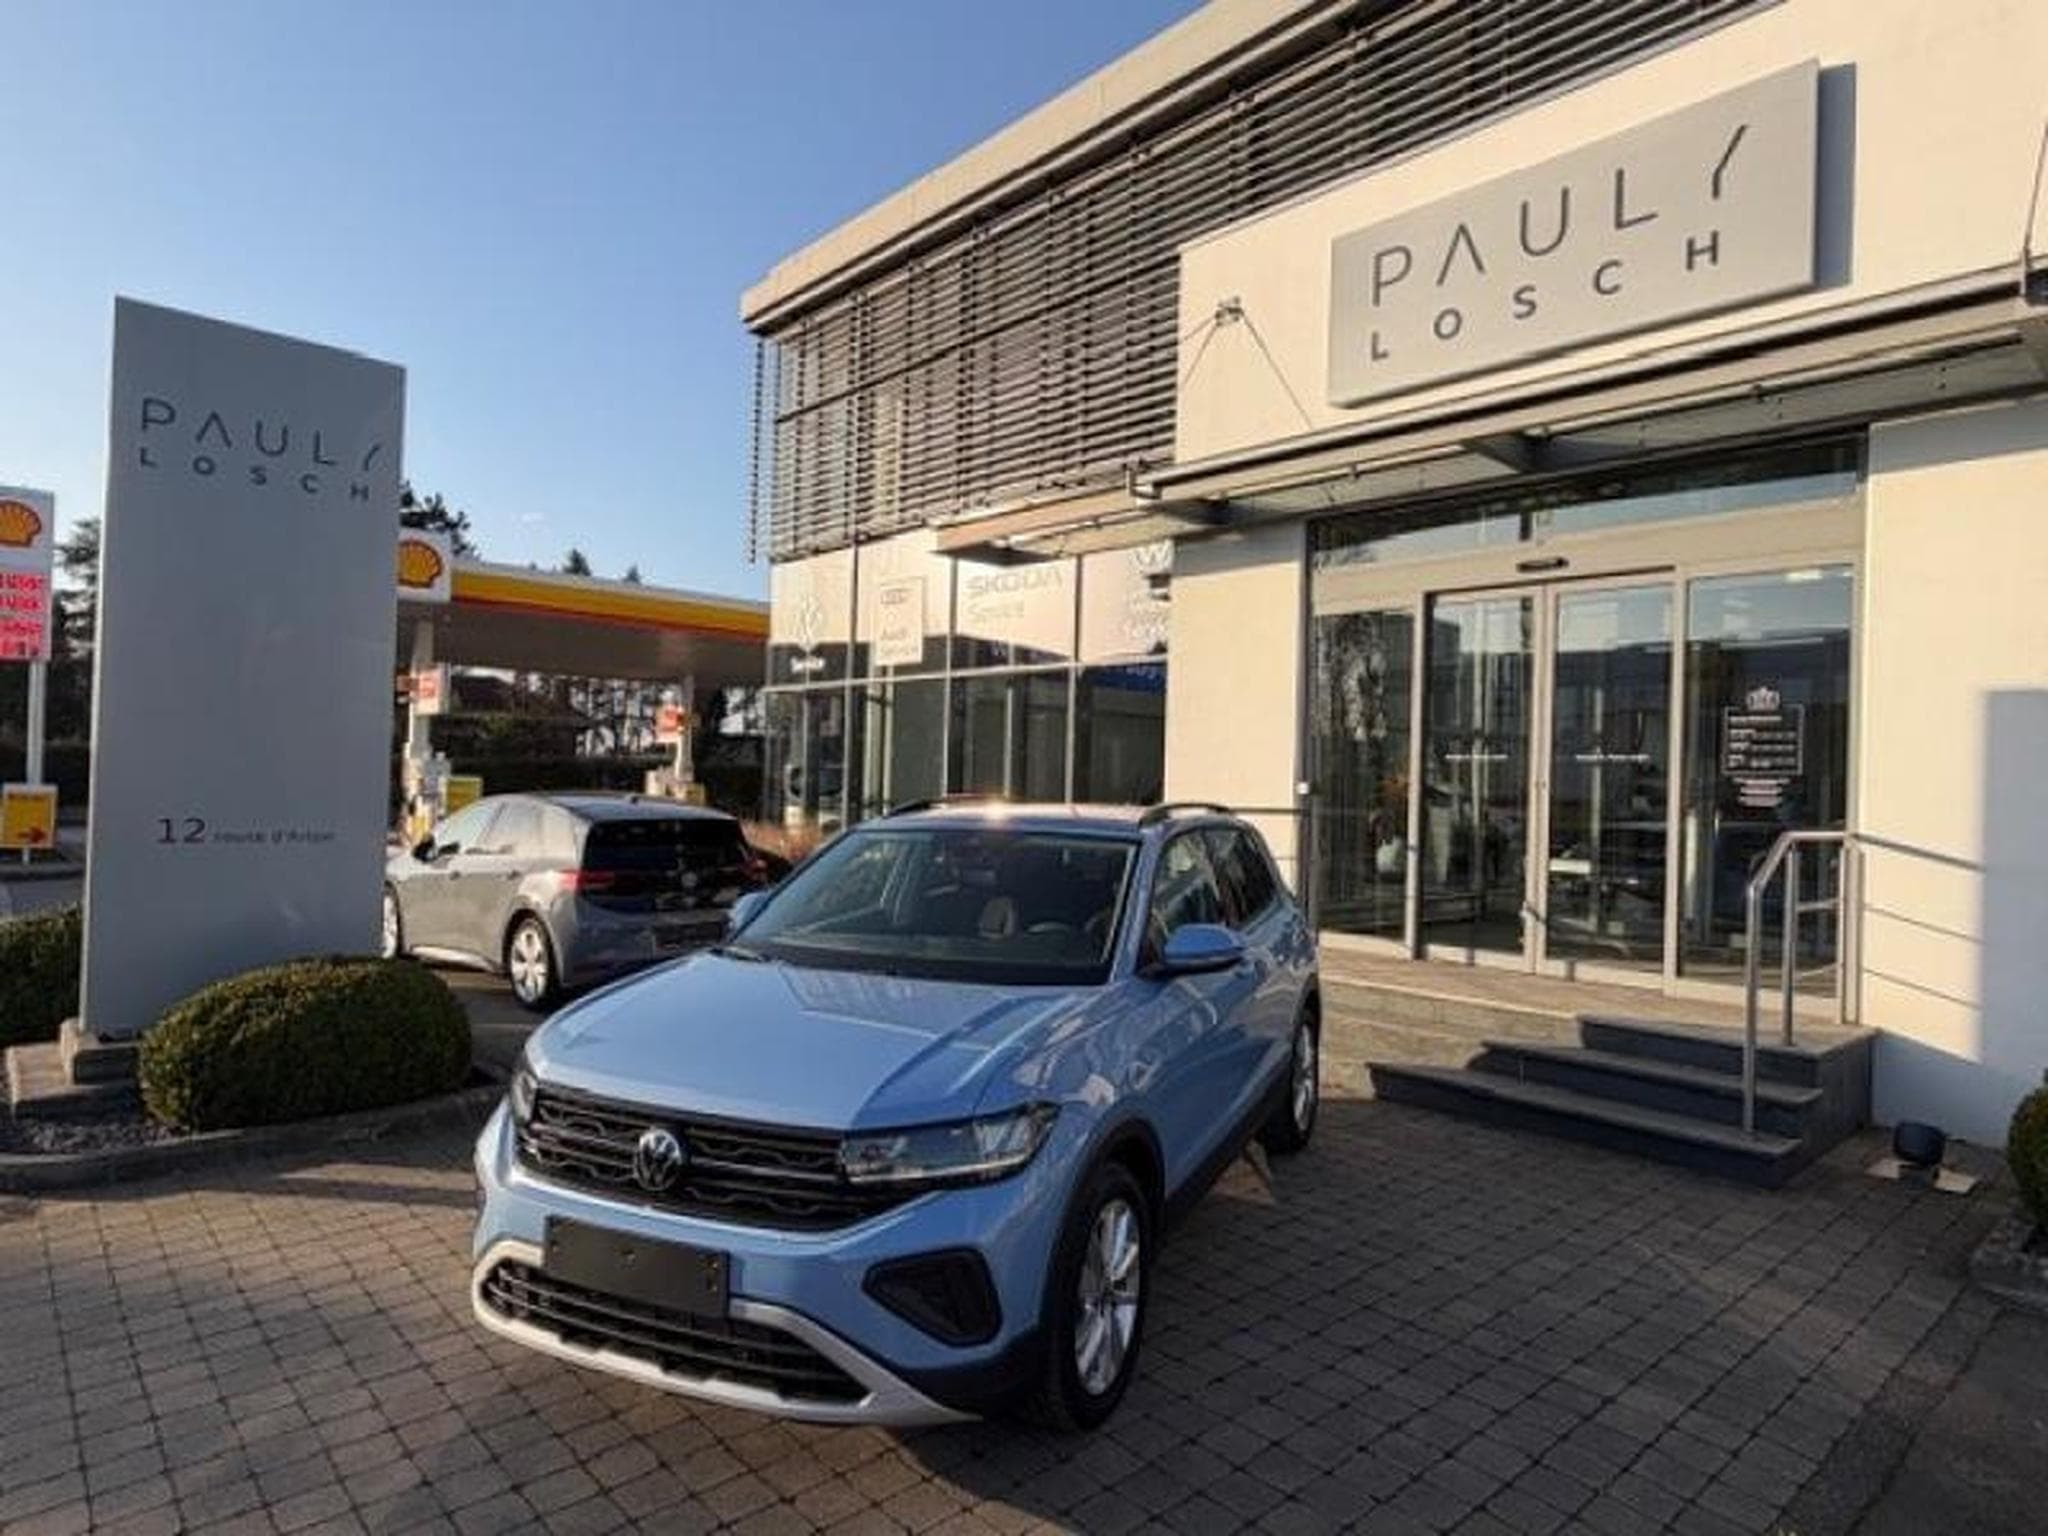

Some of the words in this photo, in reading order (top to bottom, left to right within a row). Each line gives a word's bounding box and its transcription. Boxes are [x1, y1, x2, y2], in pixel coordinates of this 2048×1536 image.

[1371, 123, 1749, 308] PAULY
[1370, 230, 1719, 362] LOSCH
[139, 446, 370, 501] LOSCH
[157, 817, 207, 845] 12
